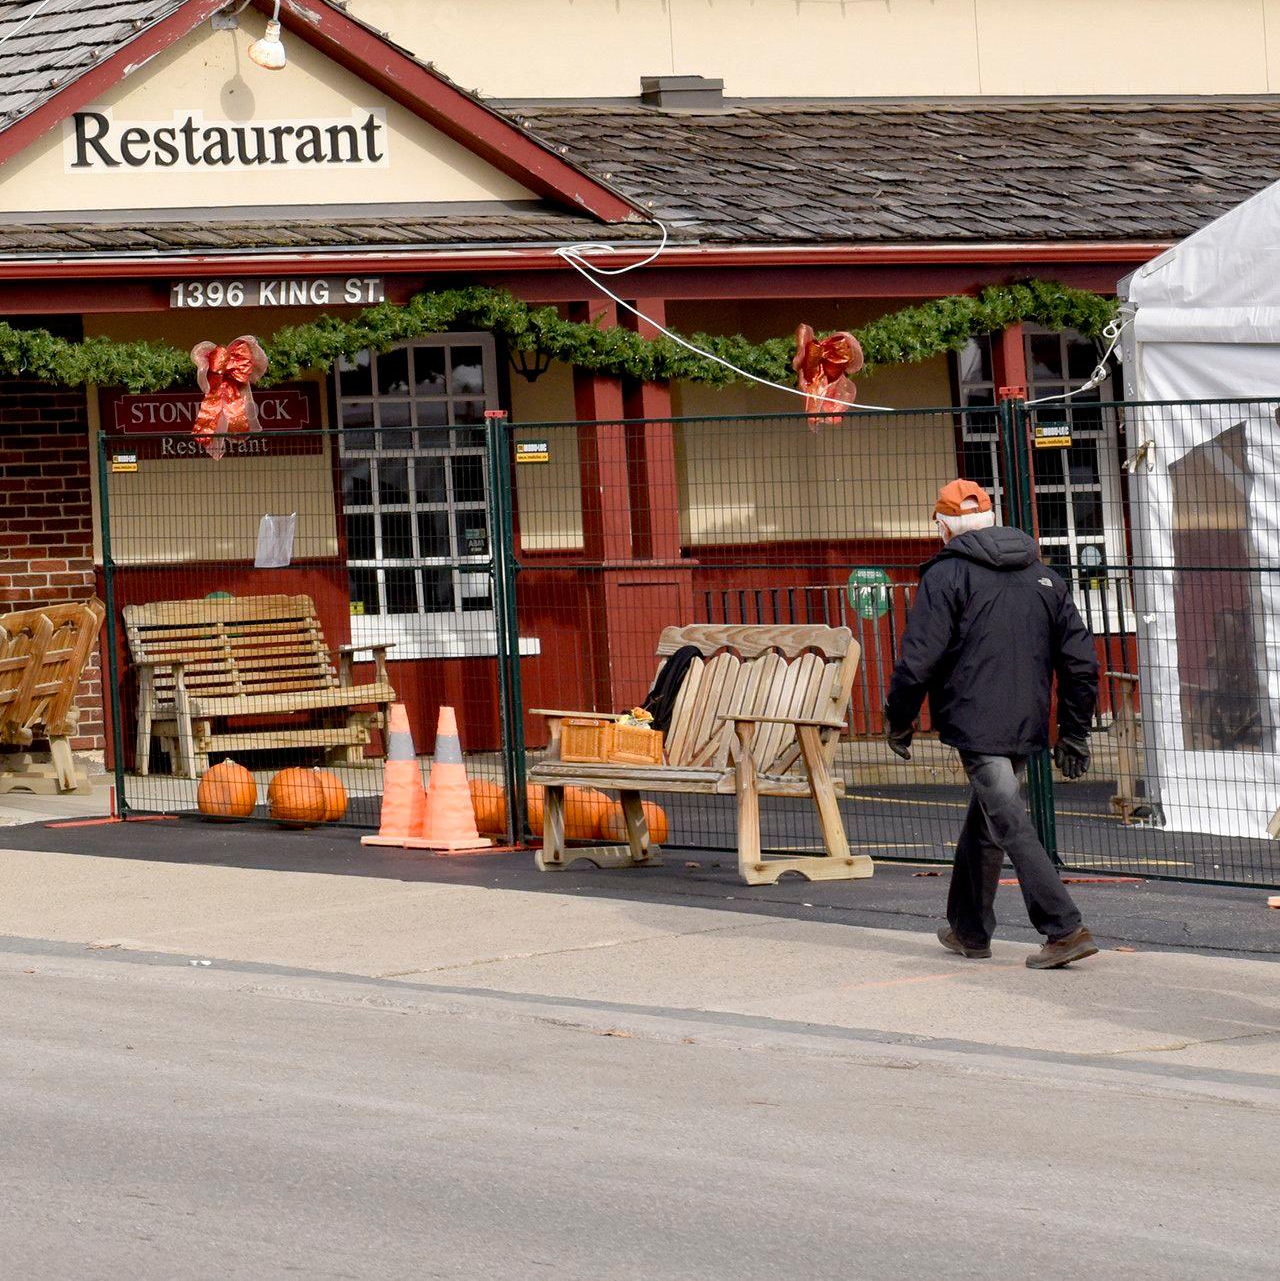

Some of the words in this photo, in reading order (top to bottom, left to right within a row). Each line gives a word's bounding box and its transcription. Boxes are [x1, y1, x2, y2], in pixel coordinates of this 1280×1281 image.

[71, 111, 384, 168] Restaurant
[173, 281, 244, 308] 1396
[259, 279, 329, 306] KING
[344, 278, 385, 303] ST.
